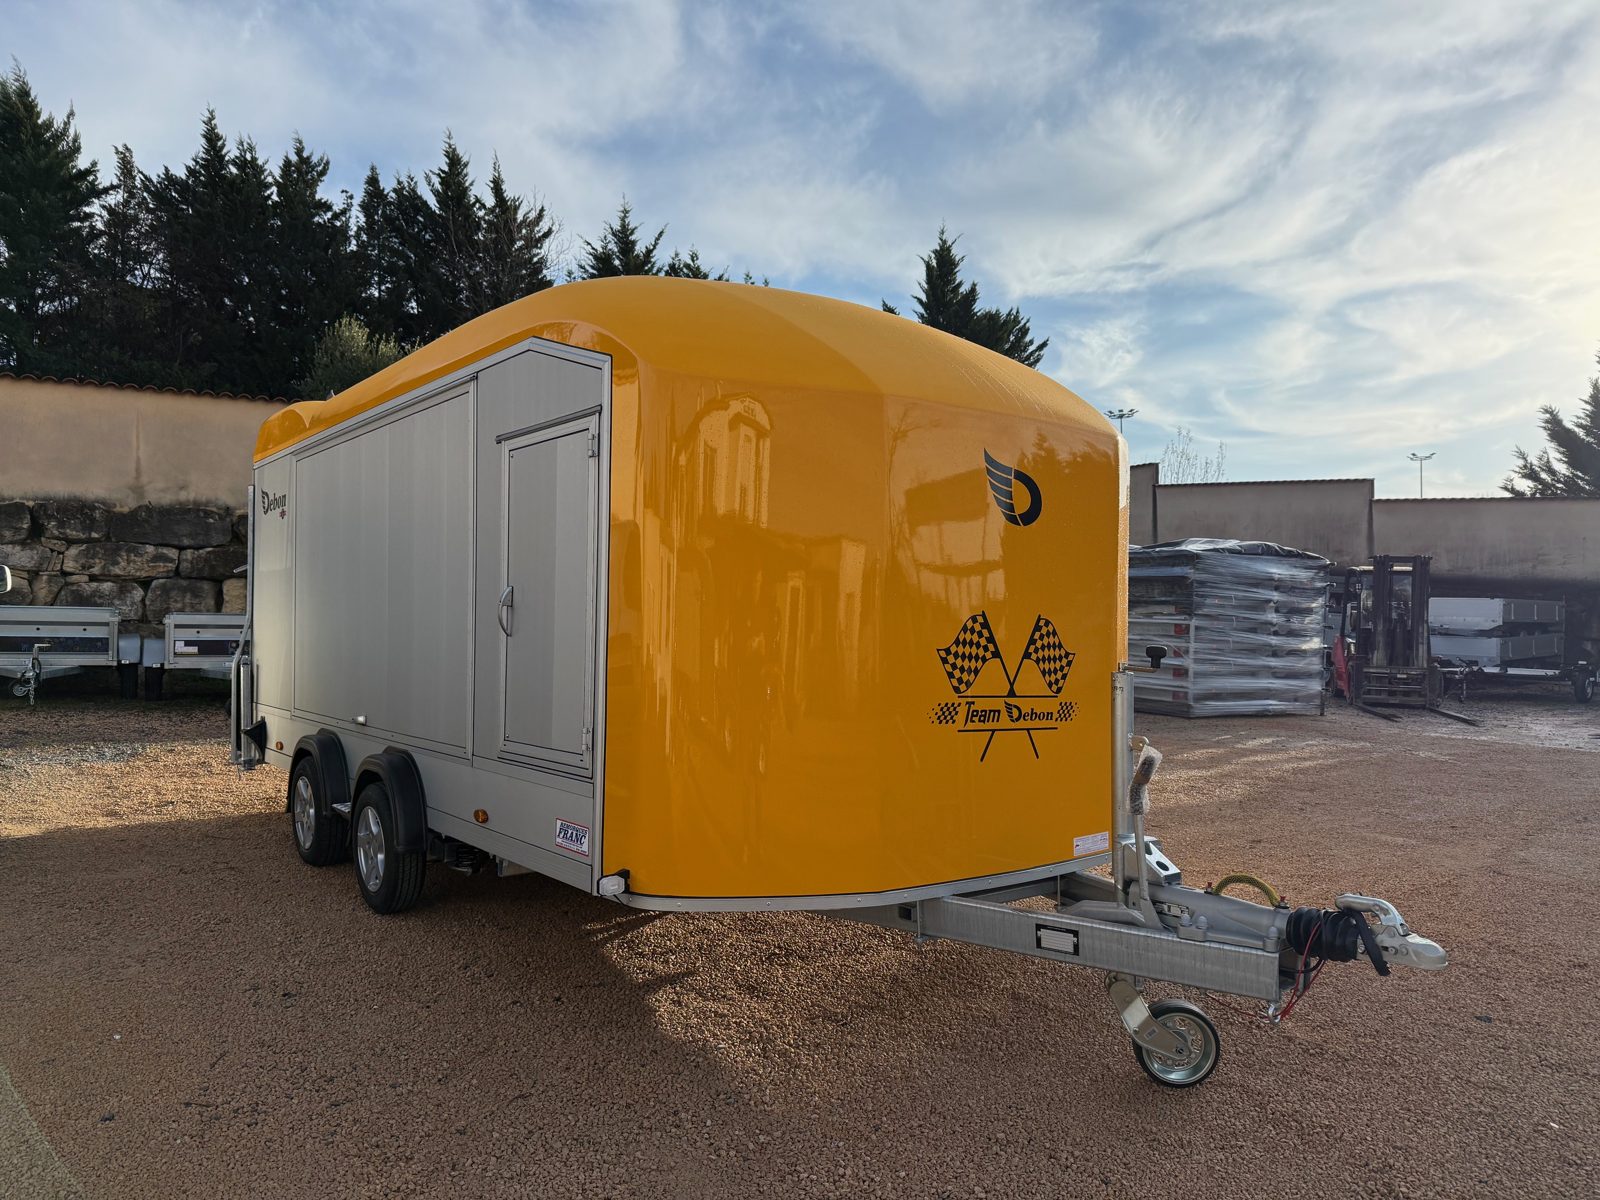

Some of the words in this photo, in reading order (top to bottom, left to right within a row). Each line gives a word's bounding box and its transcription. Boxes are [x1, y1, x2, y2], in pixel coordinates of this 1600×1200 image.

[261, 487, 287, 516] Debon
[963, 700, 1001, 728] Team
[1003, 699, 1054, 724] Debon
[557, 827, 587, 846] FRANC
